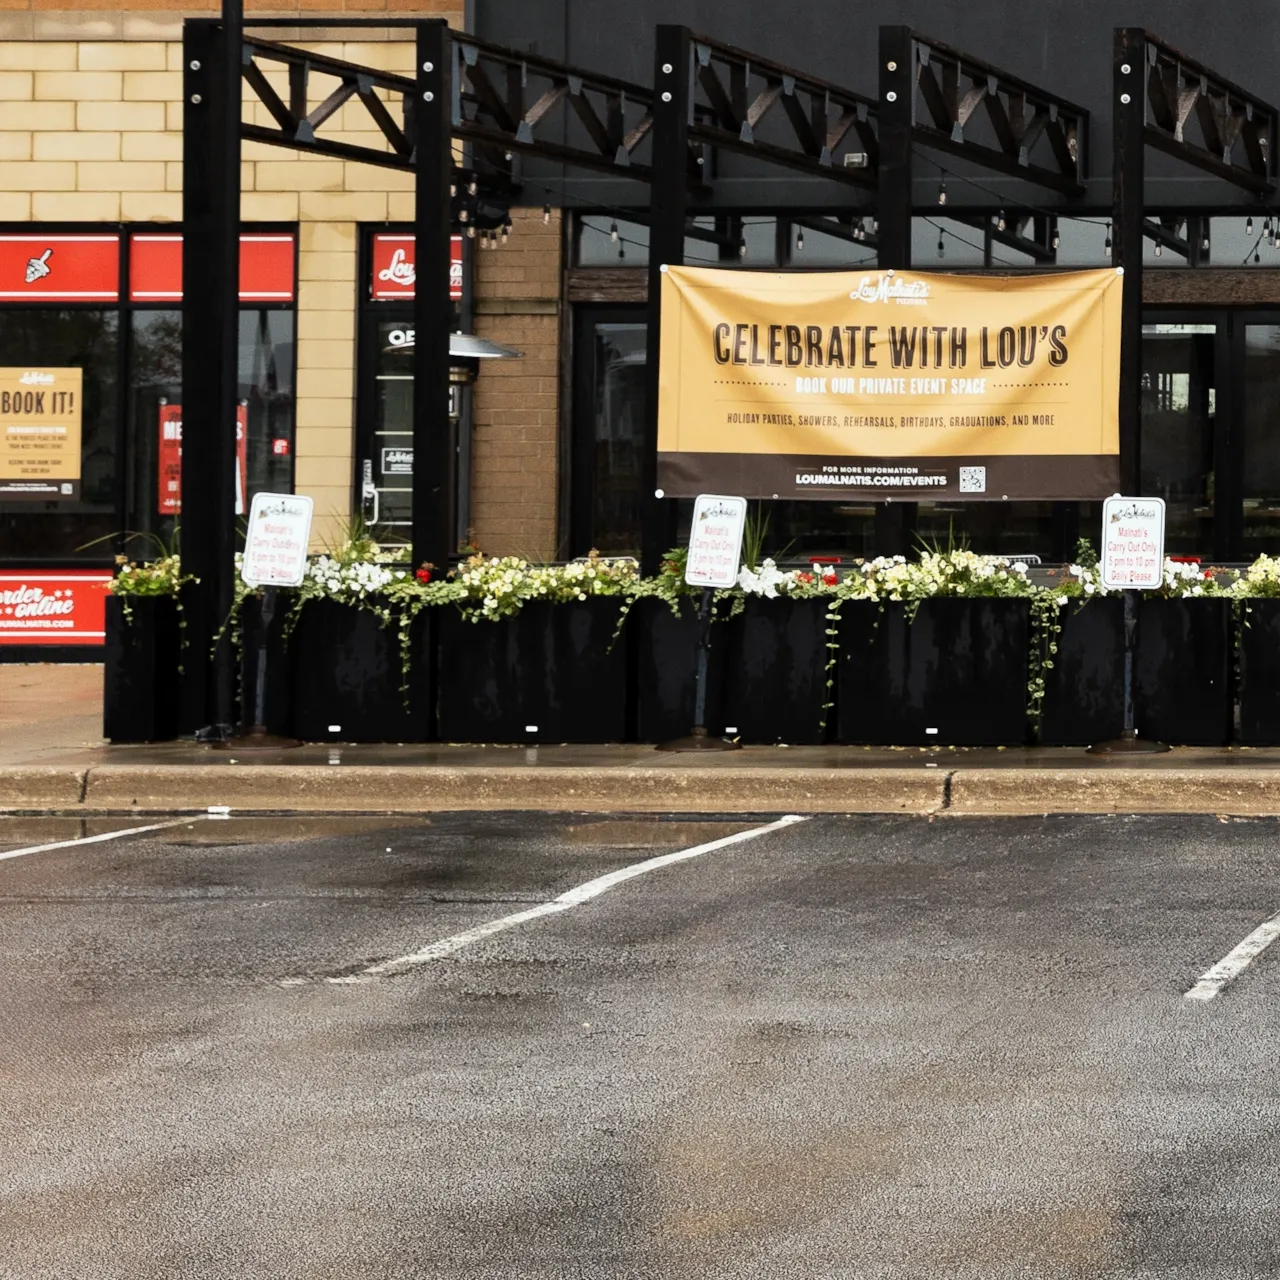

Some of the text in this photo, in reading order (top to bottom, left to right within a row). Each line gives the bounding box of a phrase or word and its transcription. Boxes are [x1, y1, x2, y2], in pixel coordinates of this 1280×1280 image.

[378, 249, 416, 286] Lou
[850, 276, 878, 303] Lou
[713, 322, 1068, 369] CELEBRATE WITH LOU'S
[795, 377, 987, 395] BOOK OUR PRIVATE EVENT SPACE
[1, 391, 75, 414] BOOK IT!
[727, 413, 1055, 429] HOLIDAY PARTIES, SHOWERS, REHEARSALS, BIRTHDAYS, GRADUATIONS, AND MORE
[796, 474, 947, 486] LOUMALNATIS.COM/EVENTS
[840, 466, 862, 474] MORE
[15, 595, 75, 618] online
